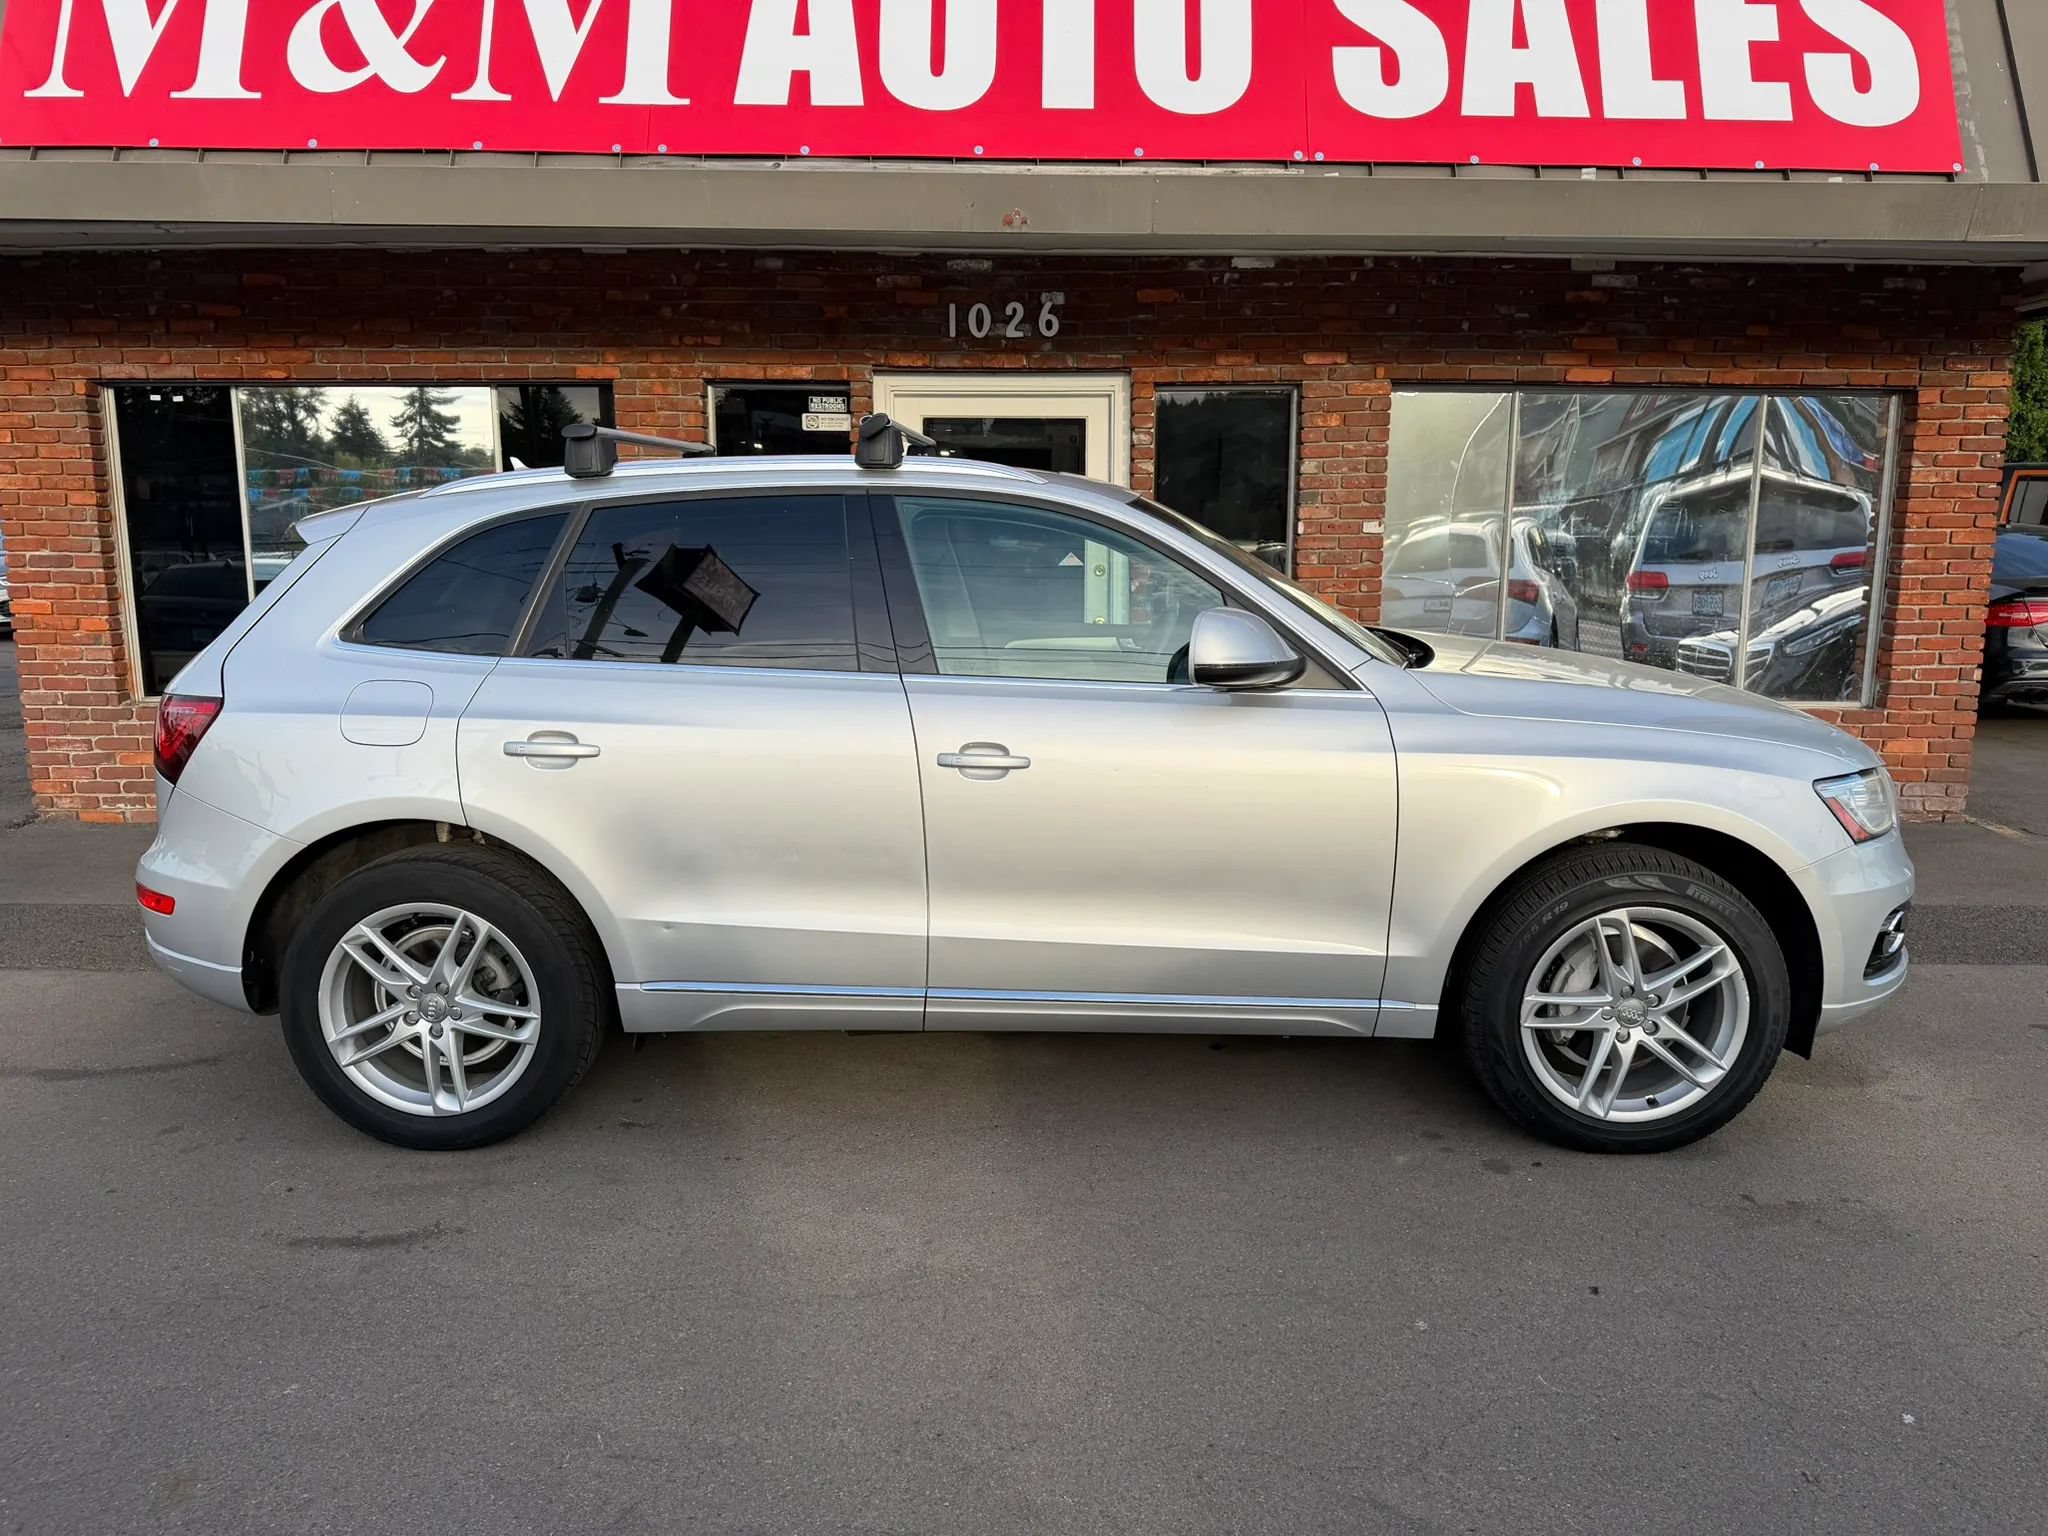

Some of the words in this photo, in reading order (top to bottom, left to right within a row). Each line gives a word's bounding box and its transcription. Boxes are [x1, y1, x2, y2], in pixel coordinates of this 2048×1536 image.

[23, 0, 691, 105] M&M
[1331, 0, 1921, 127] SALES
[949, 301, 1060, 339] 1026
[1542, 901, 1569, 924] R19
